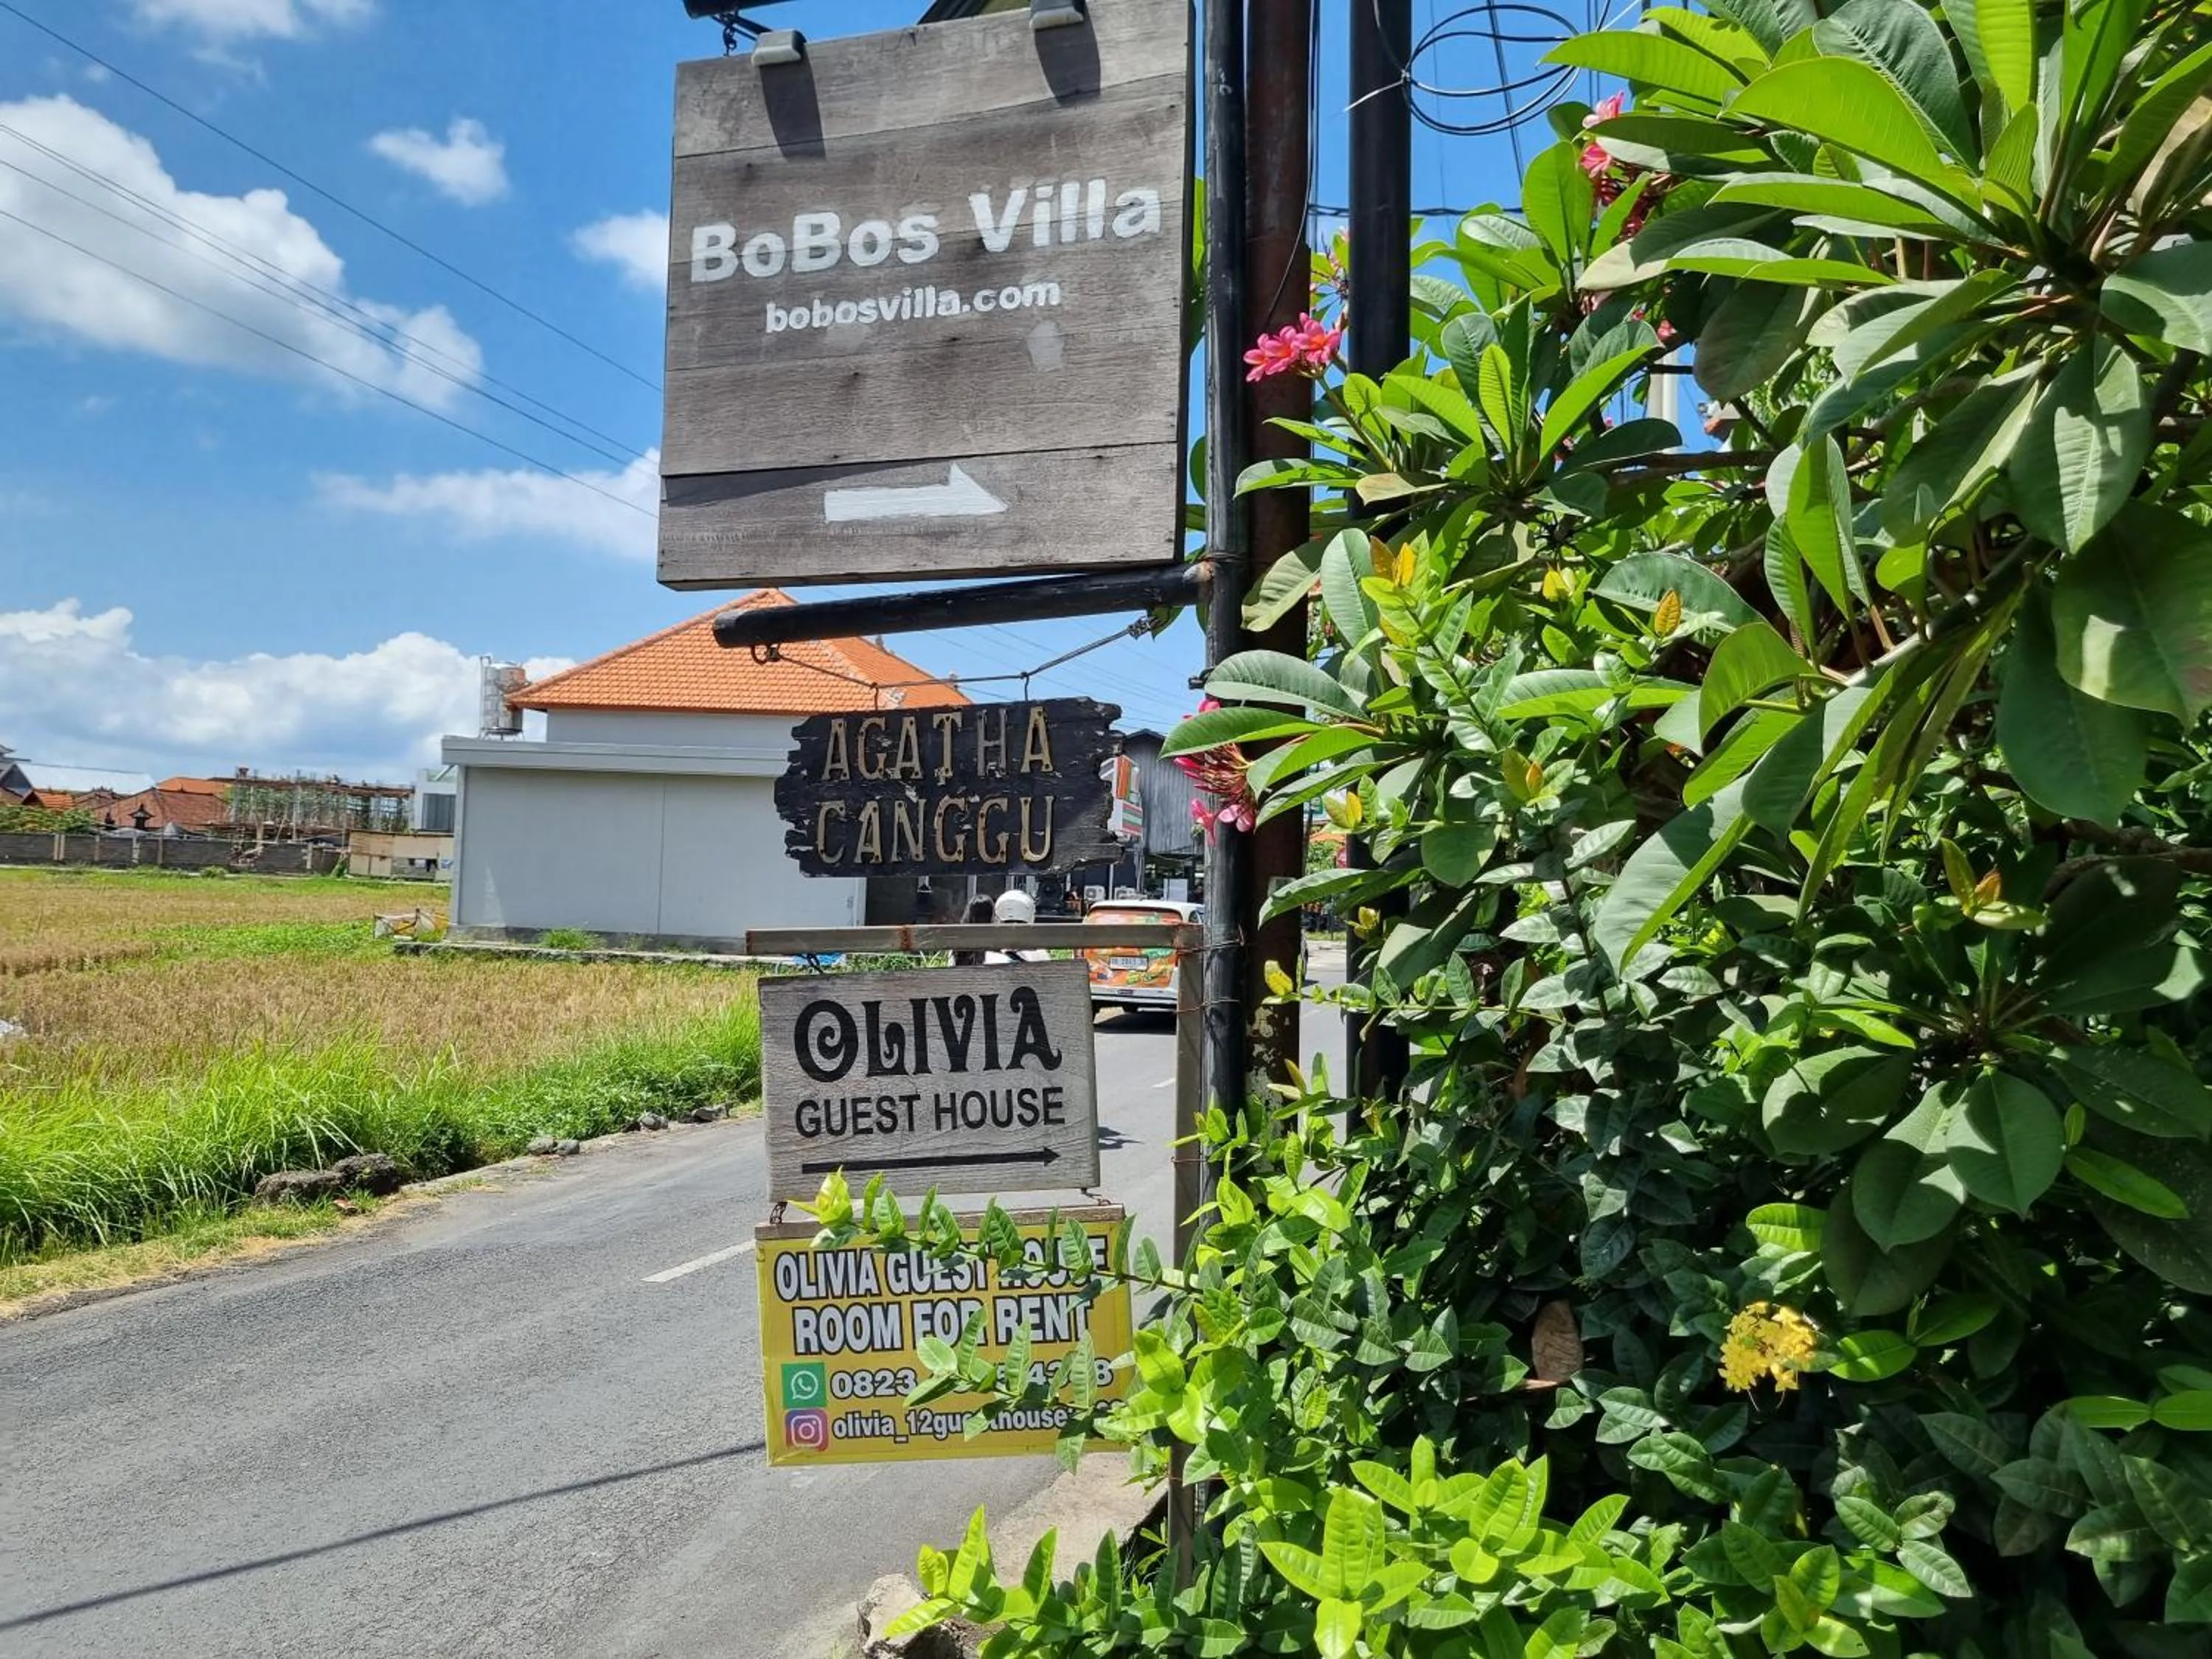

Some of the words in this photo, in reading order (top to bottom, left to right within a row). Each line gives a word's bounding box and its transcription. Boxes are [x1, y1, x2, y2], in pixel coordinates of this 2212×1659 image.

[691, 211, 940, 282] BoBos
[968, 178, 1161, 253] Villa
[765, 281, 1061, 334] bobosvilla.com
[821, 706, 1054, 782] AGATHA
[816, 795, 1054, 864] CANGGU
[794, 986, 1062, 1082] OLIVIA
[795, 1093, 921, 1138] GUEST
[934, 1086, 1066, 1131] HOUSE
[774, 1248, 882, 1302] OLIVIA
[792, 1303, 905, 1355] ROOM
[993, 1292, 1093, 1346] RENT
[830, 1367, 917, 1399] 0823
